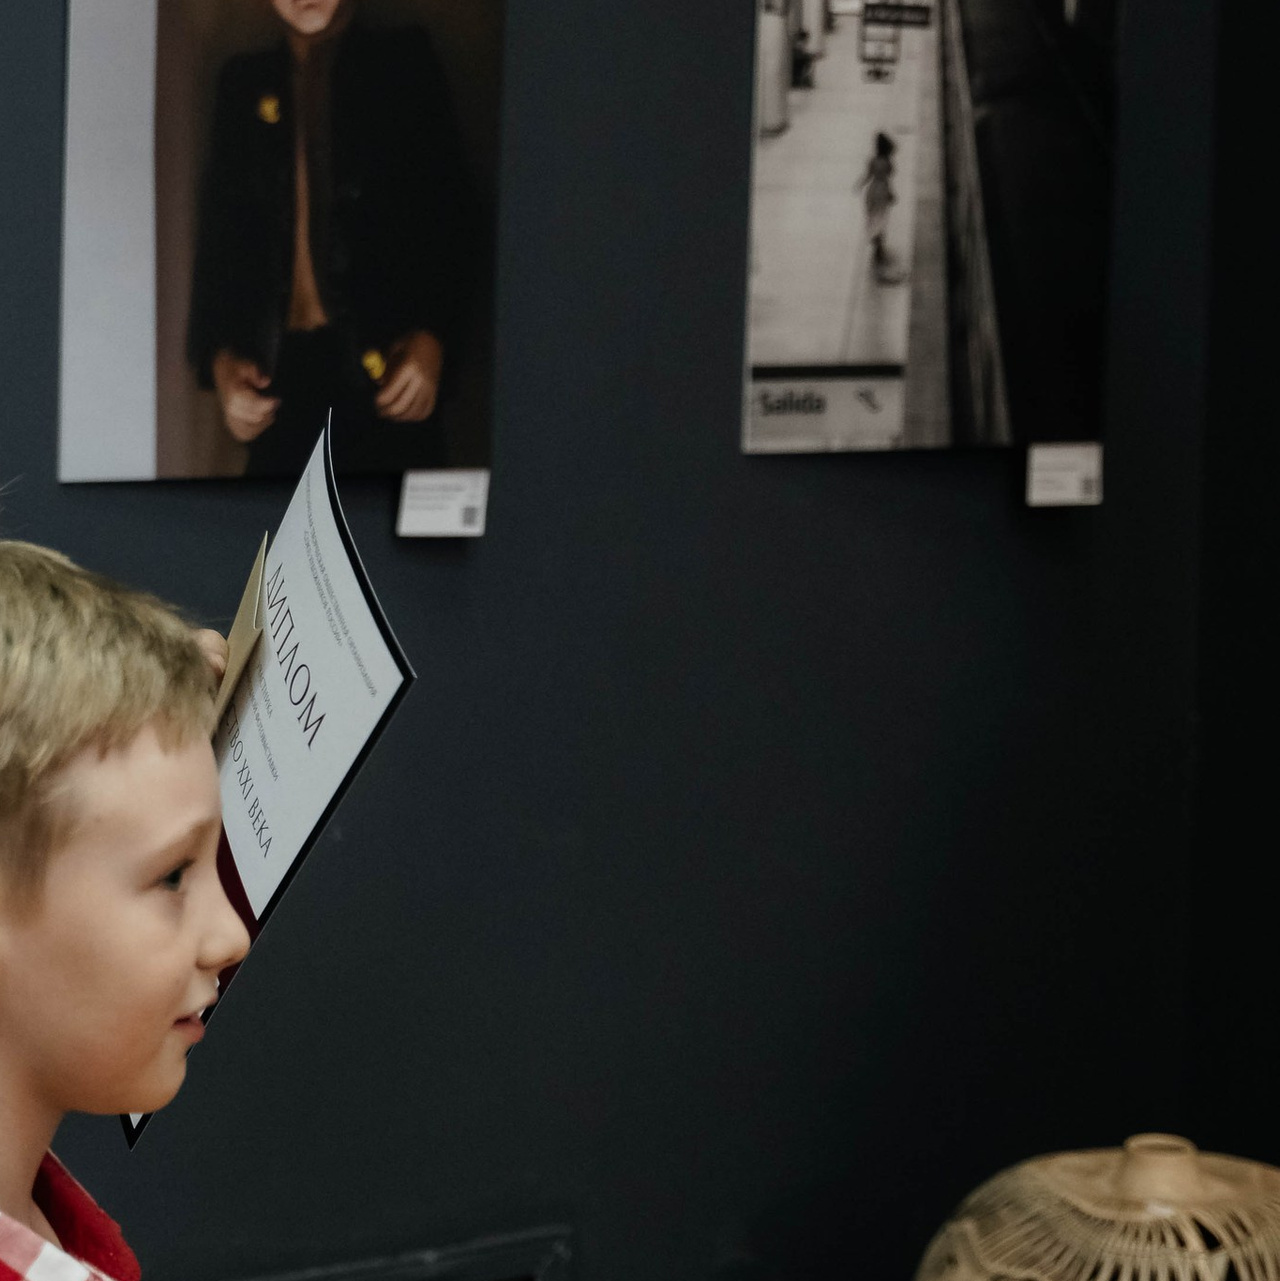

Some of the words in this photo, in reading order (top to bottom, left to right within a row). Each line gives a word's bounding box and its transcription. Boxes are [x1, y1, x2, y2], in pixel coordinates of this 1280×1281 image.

[266, 562, 327, 750] ДИПЛОМ
[226, 703, 245, 762] СТВО
[236, 758, 255, 801] XXI
[247, 796, 273, 859] ВЕКА
